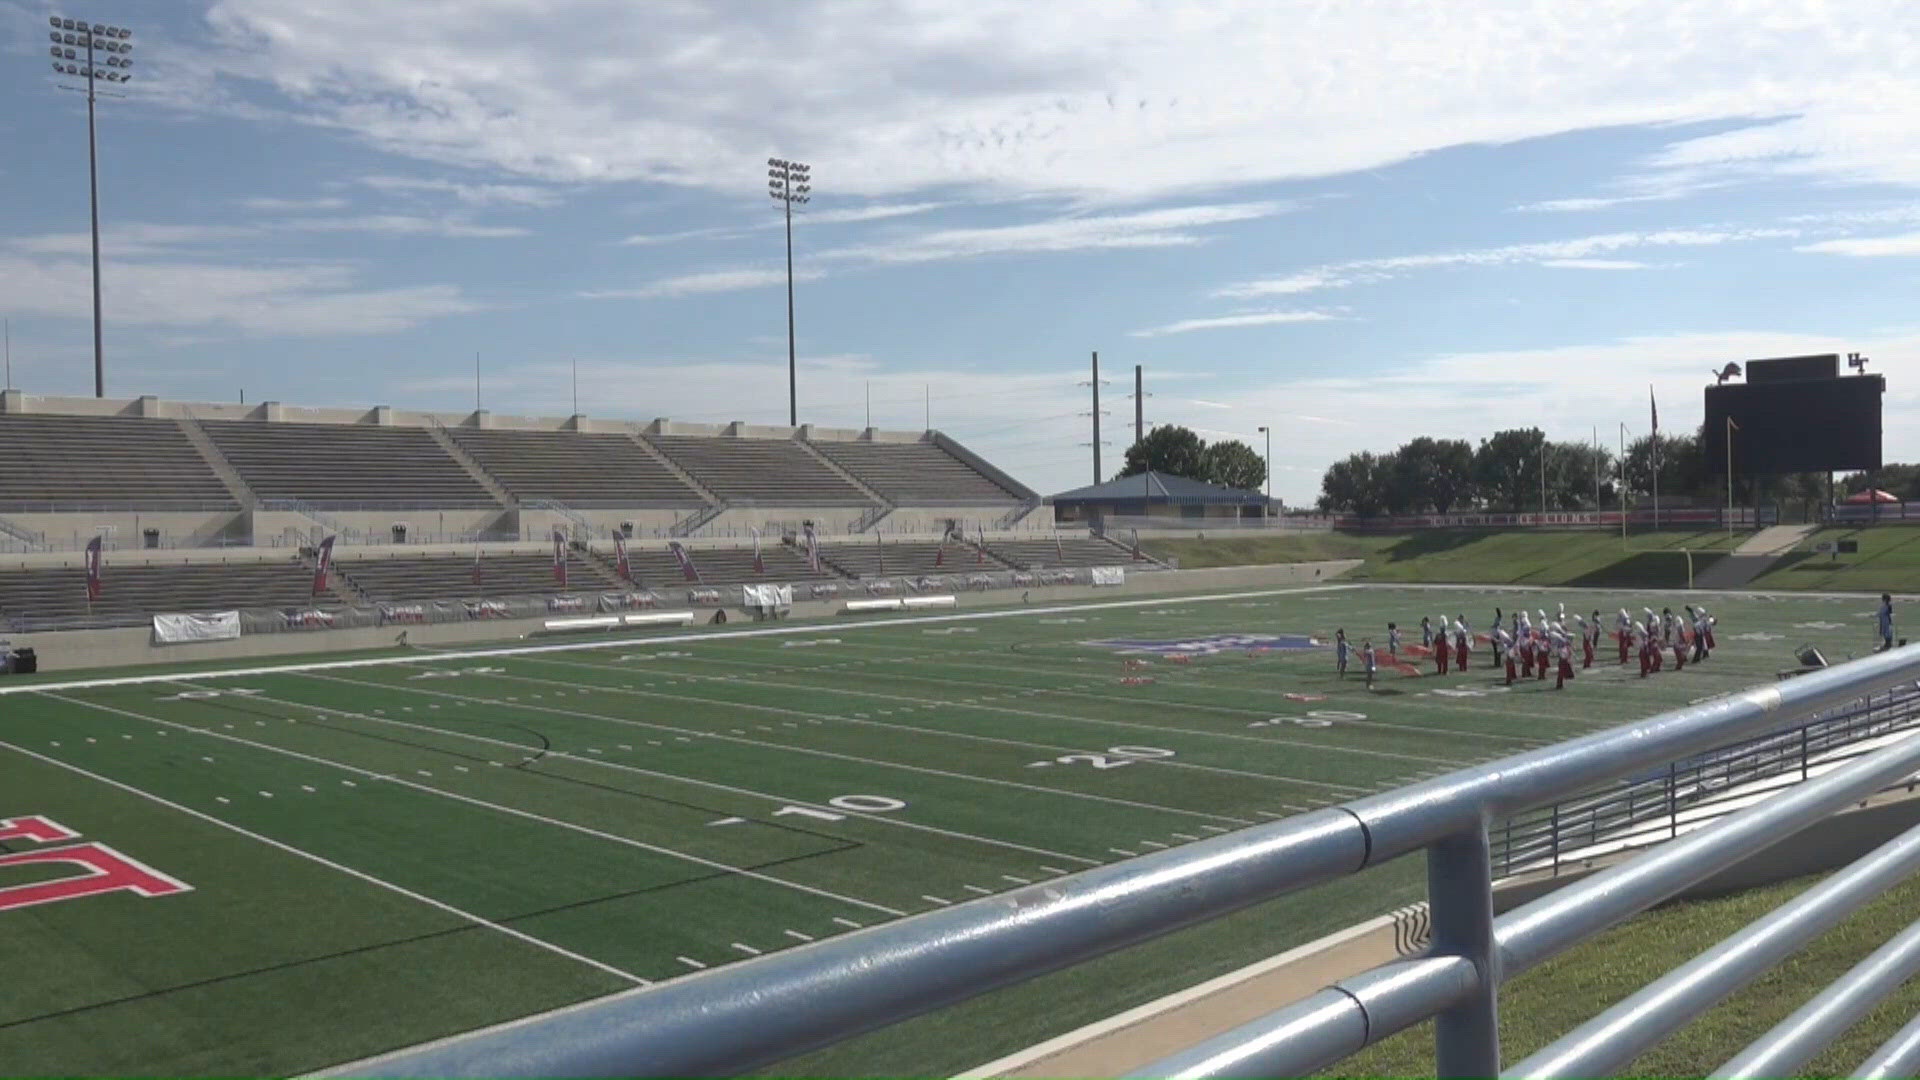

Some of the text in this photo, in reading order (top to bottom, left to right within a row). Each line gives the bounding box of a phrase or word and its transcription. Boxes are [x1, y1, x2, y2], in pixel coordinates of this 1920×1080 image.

[1545, 512, 1591, 524] LIONS
[1056, 745, 1176, 769] 20
[771, 795, 906, 821] 10
